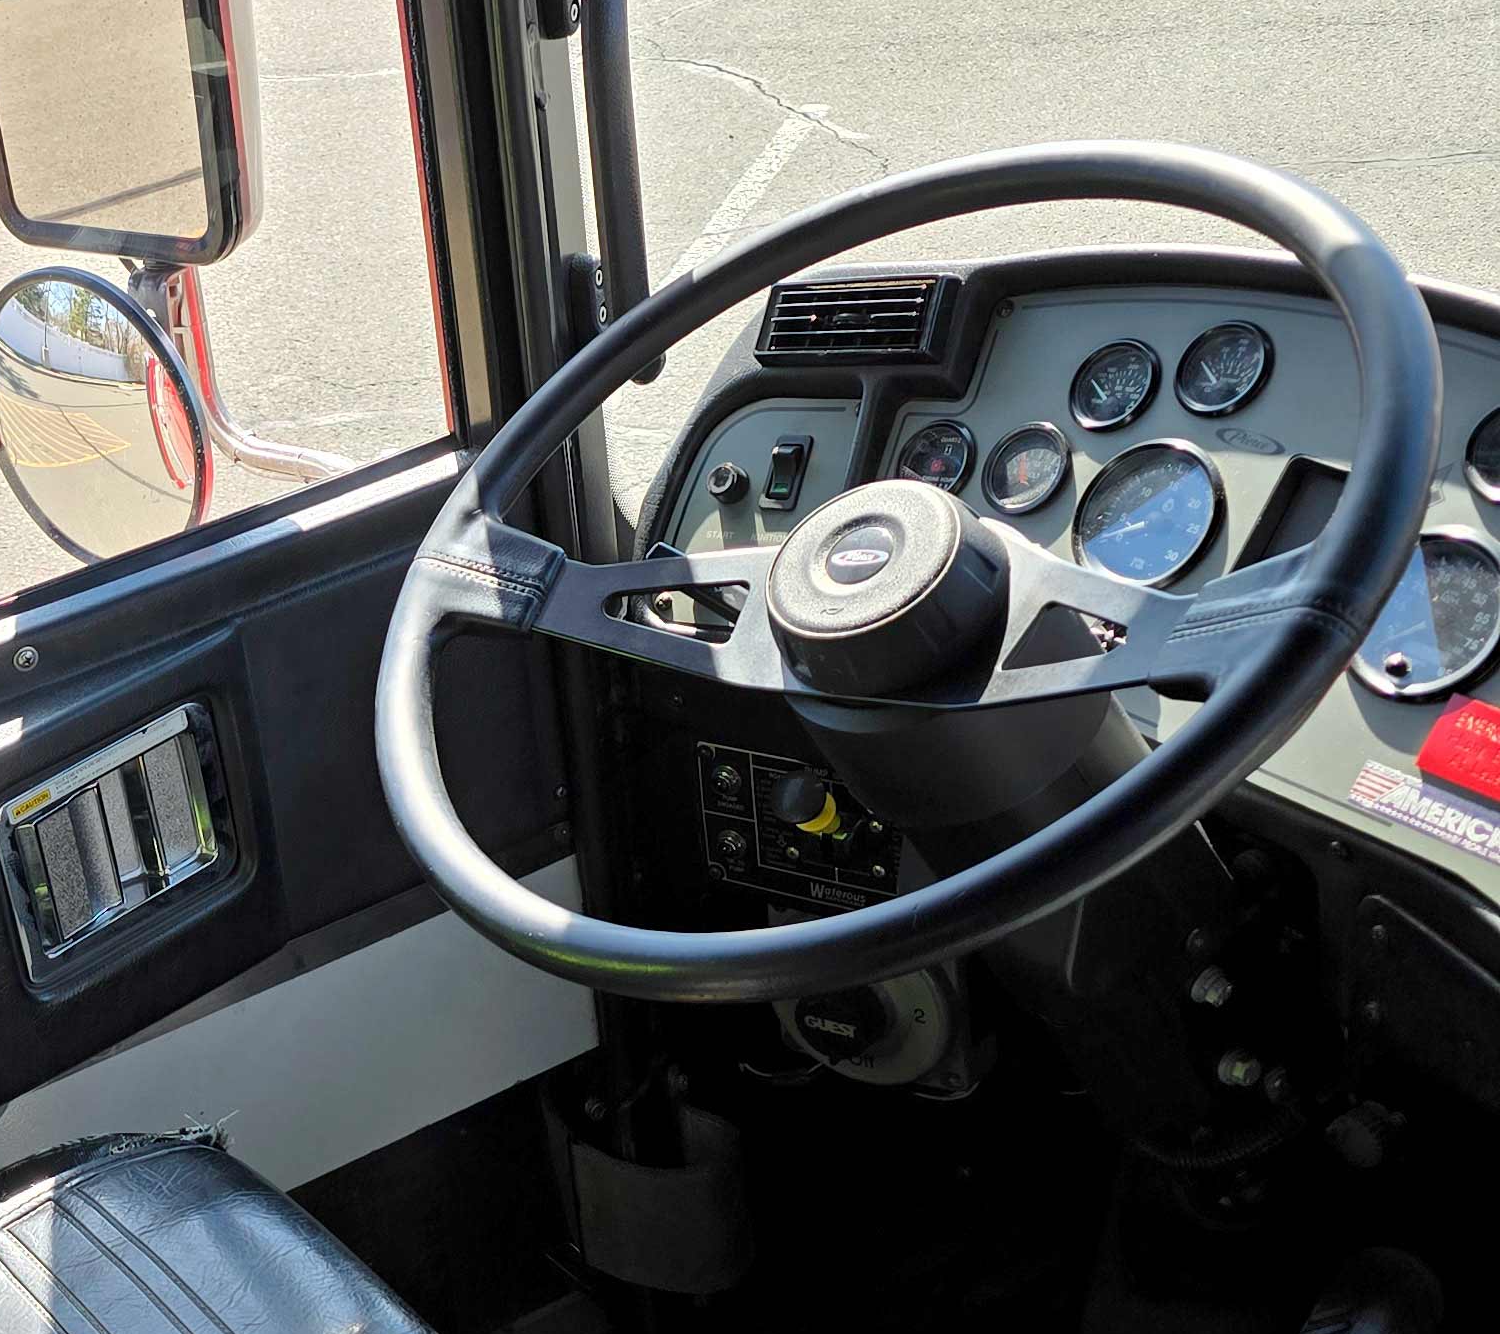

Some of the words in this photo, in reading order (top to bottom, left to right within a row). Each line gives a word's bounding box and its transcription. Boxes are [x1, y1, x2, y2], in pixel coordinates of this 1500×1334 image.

[1187, 498, 1202, 509] 20
[706, 530, 735, 540] START
[1164, 549, 1179, 562] 30
[1475, 611, 1491, 625] 65
[1463, 637, 1480, 651] 75
[20, 791, 50, 813] CAUTION
[810, 881, 867, 903] Waterous
[913, 1008, 927, 1025] 2
[804, 1016, 857, 1038] GUEST
